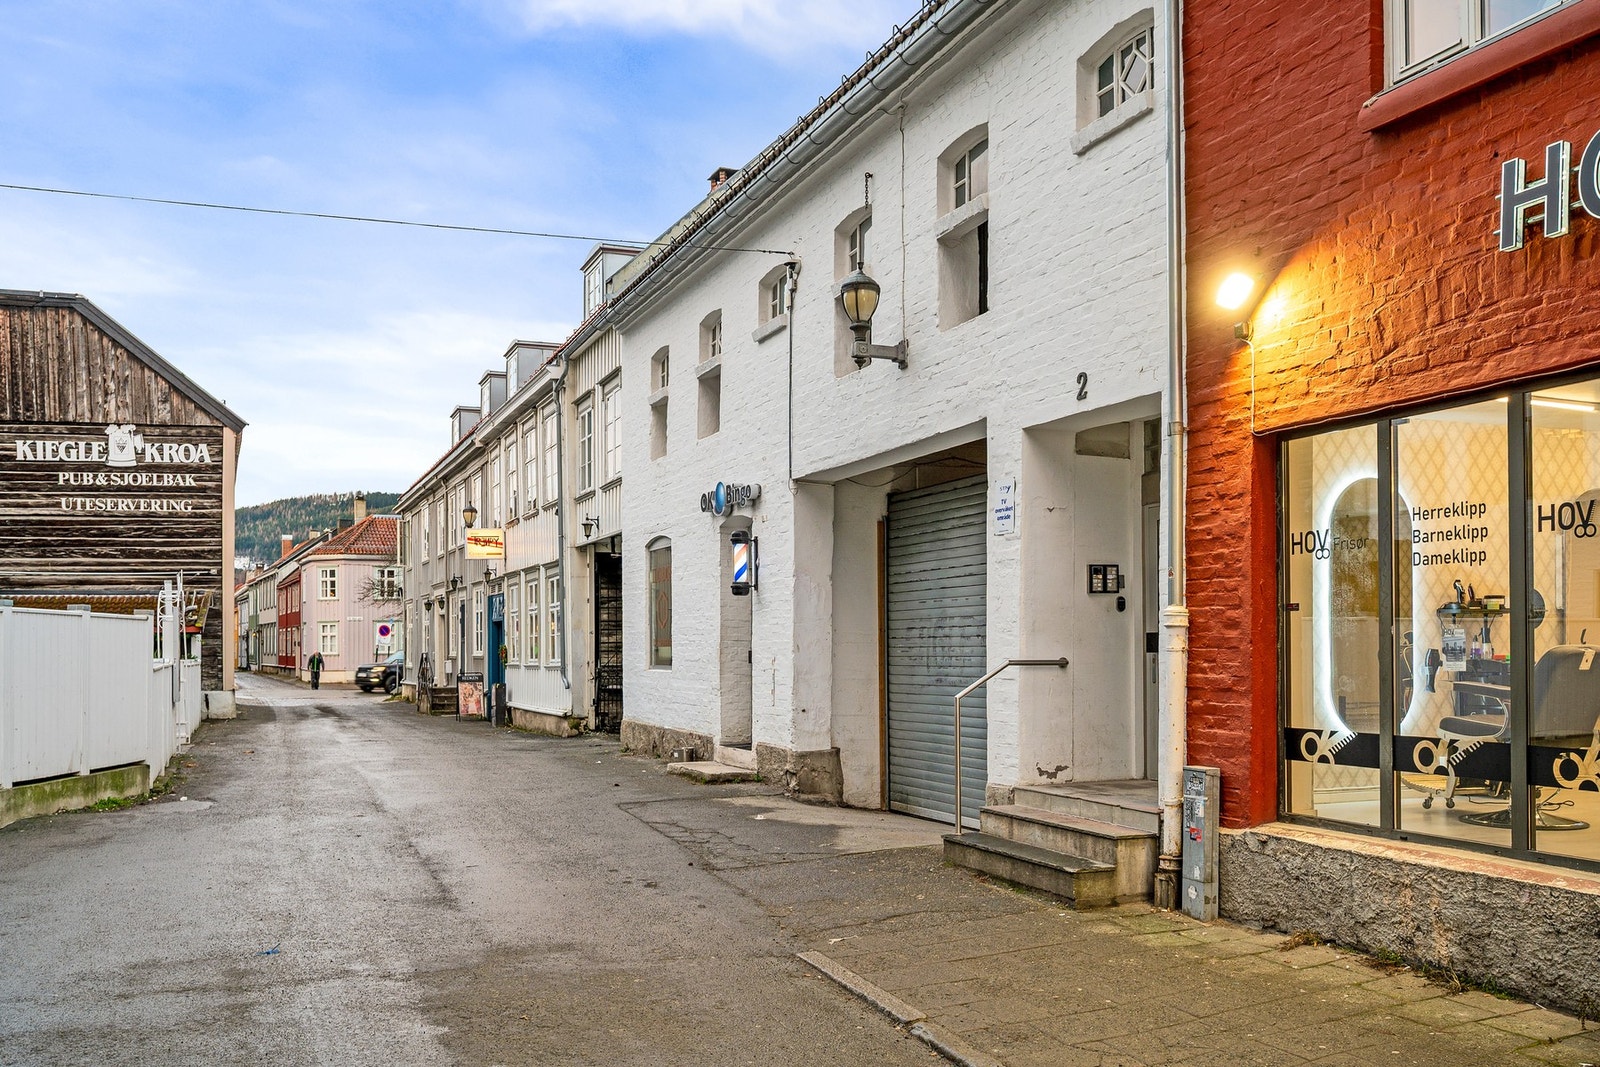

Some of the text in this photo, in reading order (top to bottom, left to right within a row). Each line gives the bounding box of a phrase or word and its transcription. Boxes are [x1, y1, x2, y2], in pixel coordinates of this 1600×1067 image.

[1076, 371, 1088, 401] 2
[15, 440, 212, 463] KIEGLE KROA
[58, 471, 94, 486] PUB
[110, 472, 197, 487] SJOELBAK
[60, 497, 193, 512] UTESERVERING
[726, 483, 751, 507] Bingo
[1412, 500, 1487, 522] Herreklipp
[1537, 499, 1597, 538] HOV
[1291, 528, 1370, 560] HOV Frisør
[1412, 524, 1489, 544] Barneklipp
[1412, 547, 1487, 567] Dameklipp
